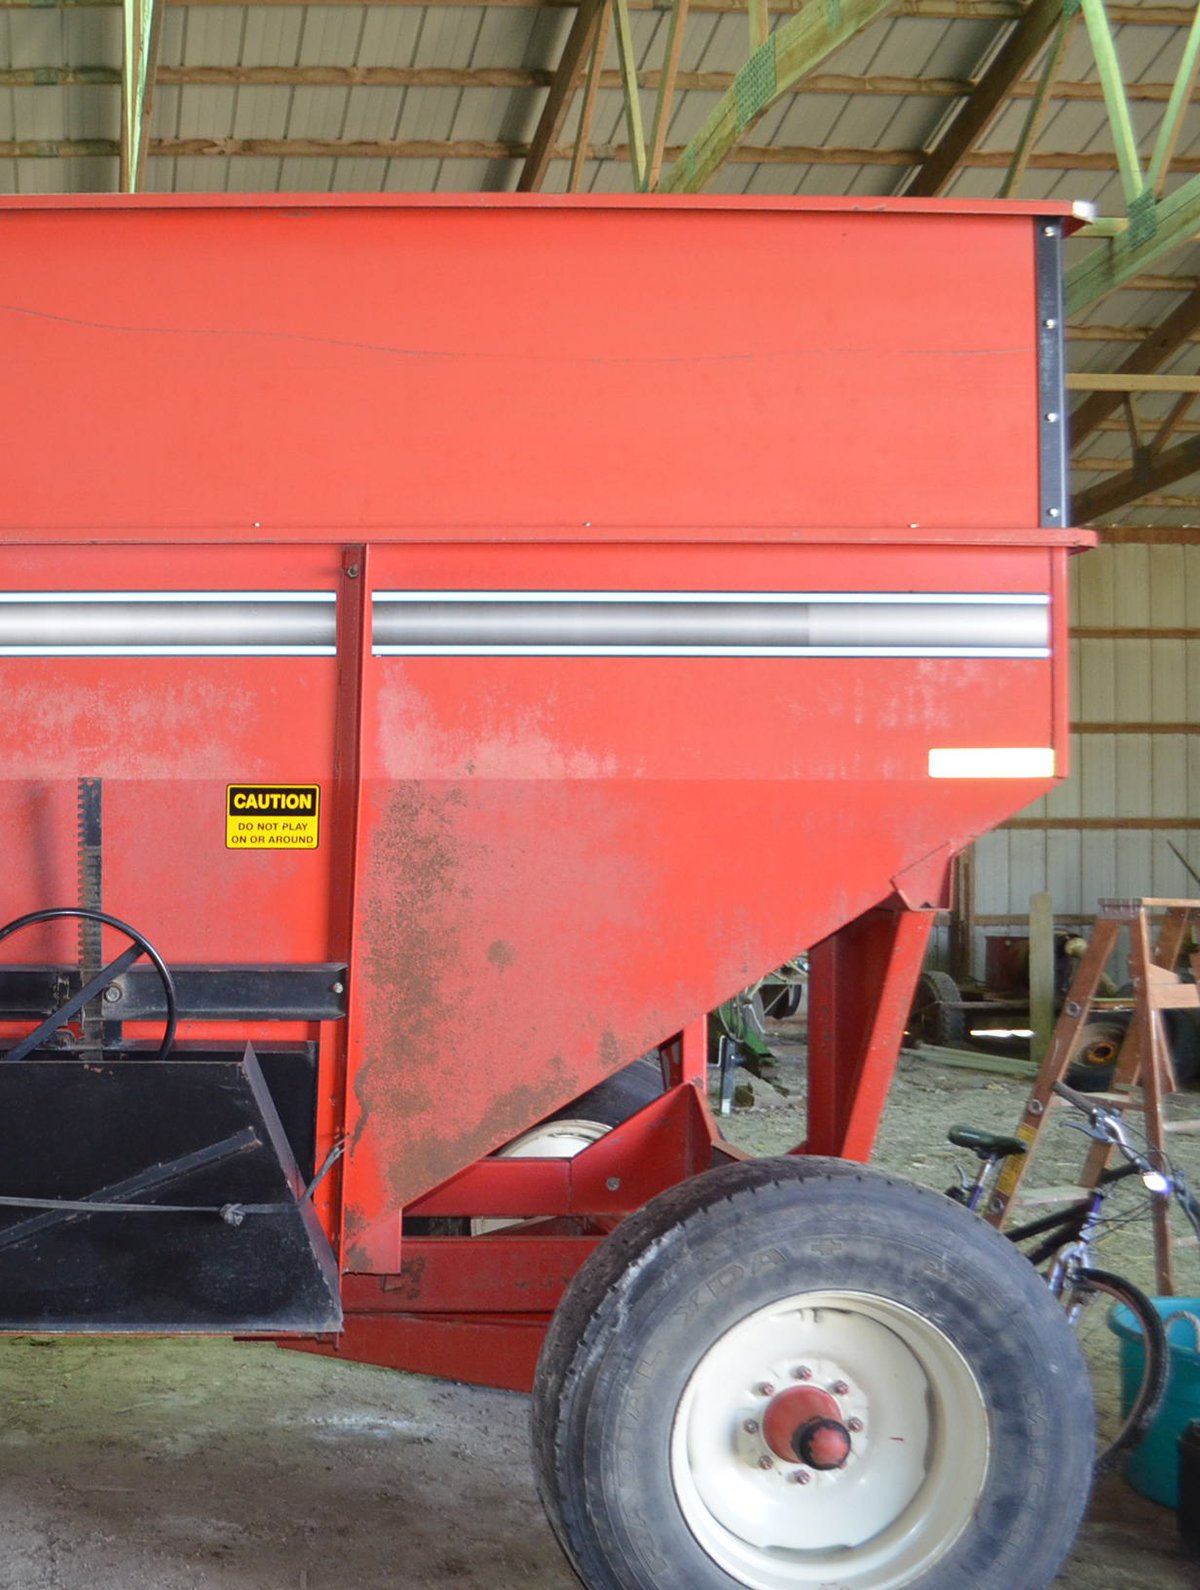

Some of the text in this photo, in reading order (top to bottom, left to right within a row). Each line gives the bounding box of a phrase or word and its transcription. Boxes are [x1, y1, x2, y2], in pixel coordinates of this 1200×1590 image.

[233, 793, 312, 810] CAUTION
[238, 823, 308, 831] DO NOT PLAY
[231, 835, 314, 844] ON OR AROUND
